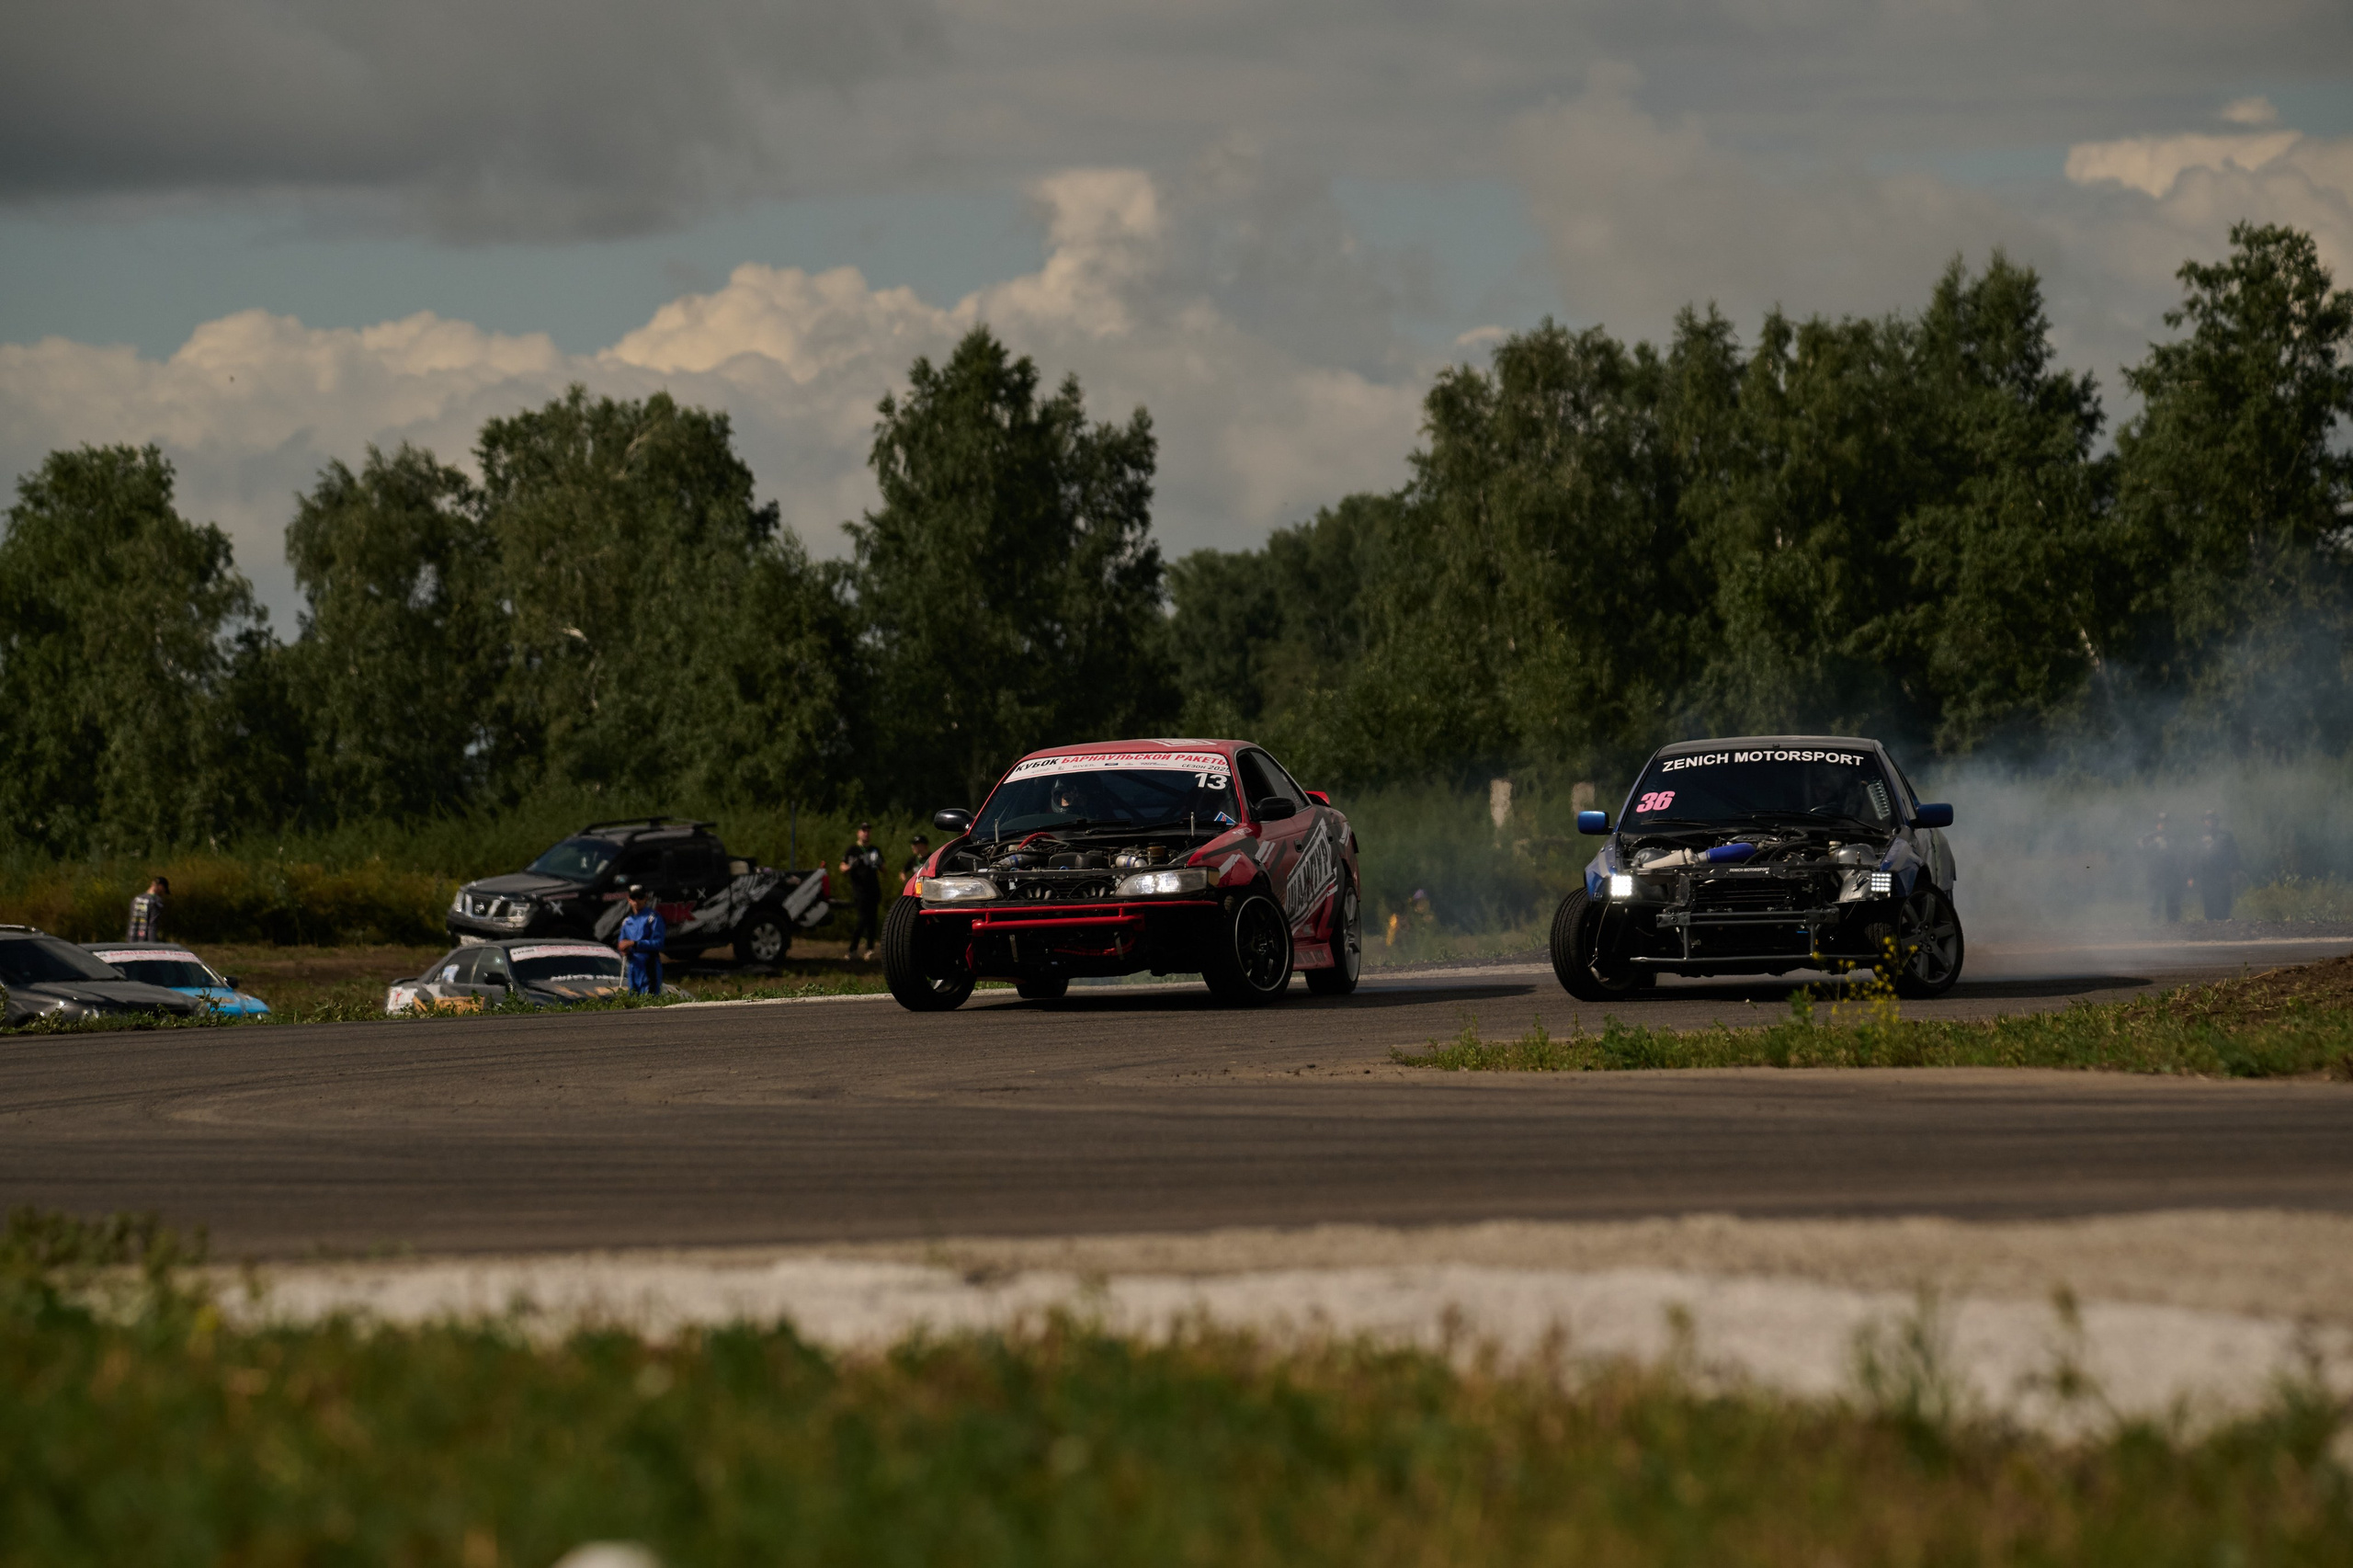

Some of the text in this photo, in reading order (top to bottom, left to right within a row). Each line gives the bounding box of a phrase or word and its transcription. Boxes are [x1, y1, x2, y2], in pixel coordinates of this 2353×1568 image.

[1015, 758, 1060, 773] КУБОК
[1061, 753, 1172, 765] БАРНАУЛЬСКОЙ
[1662, 750, 1865, 773] ZENICH MOTORSPORT
[1195, 773, 1228, 790] 13
[1636, 790, 1676, 812] 36
